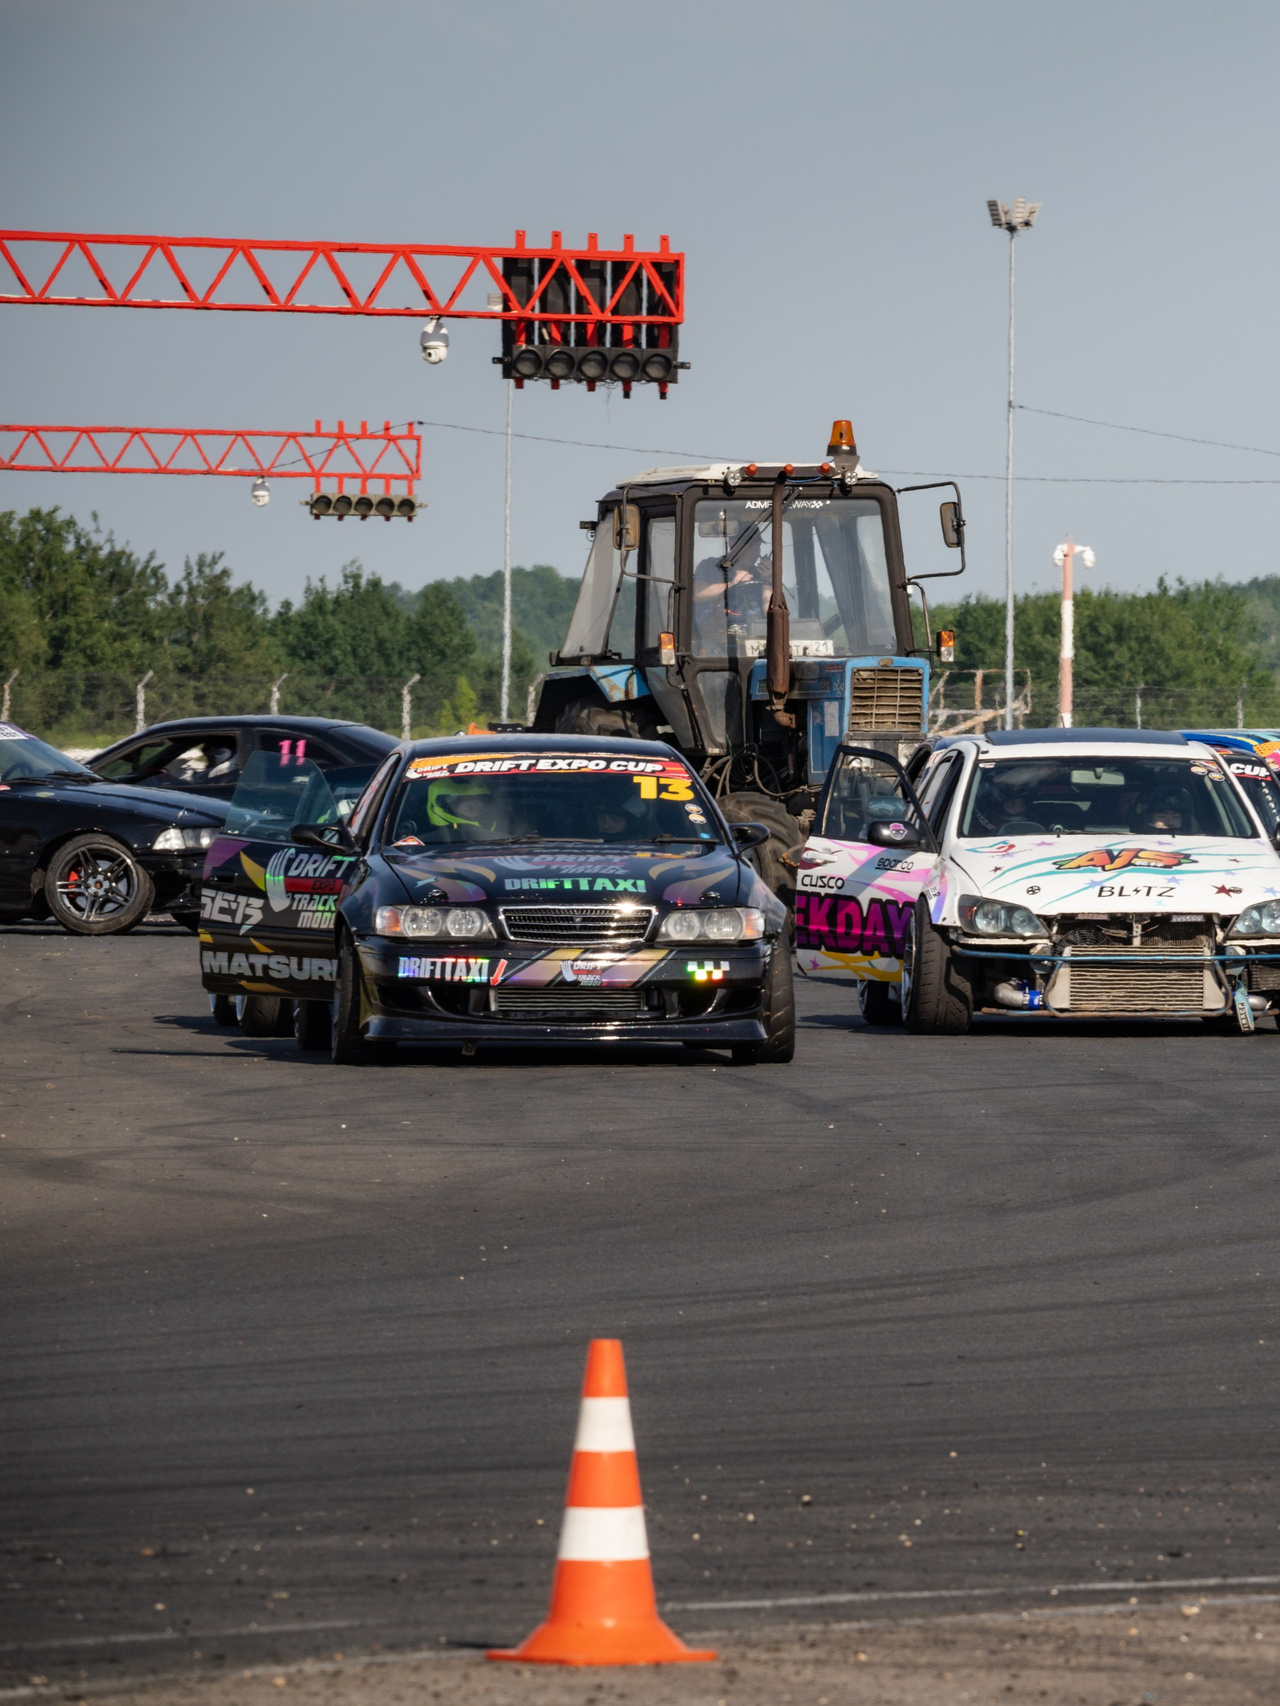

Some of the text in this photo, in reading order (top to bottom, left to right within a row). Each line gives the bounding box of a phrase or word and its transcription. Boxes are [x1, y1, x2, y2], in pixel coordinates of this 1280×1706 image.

[278, 740, 306, 767] 11
[454, 759, 664, 773] DRIFT EXPO CUP
[633, 776, 695, 801] 13
[287, 853, 358, 878] DRIFT
[877, 857, 914, 871] sparco
[801, 874, 845, 889] CUSCO
[292, 894, 338, 911] TRACK
